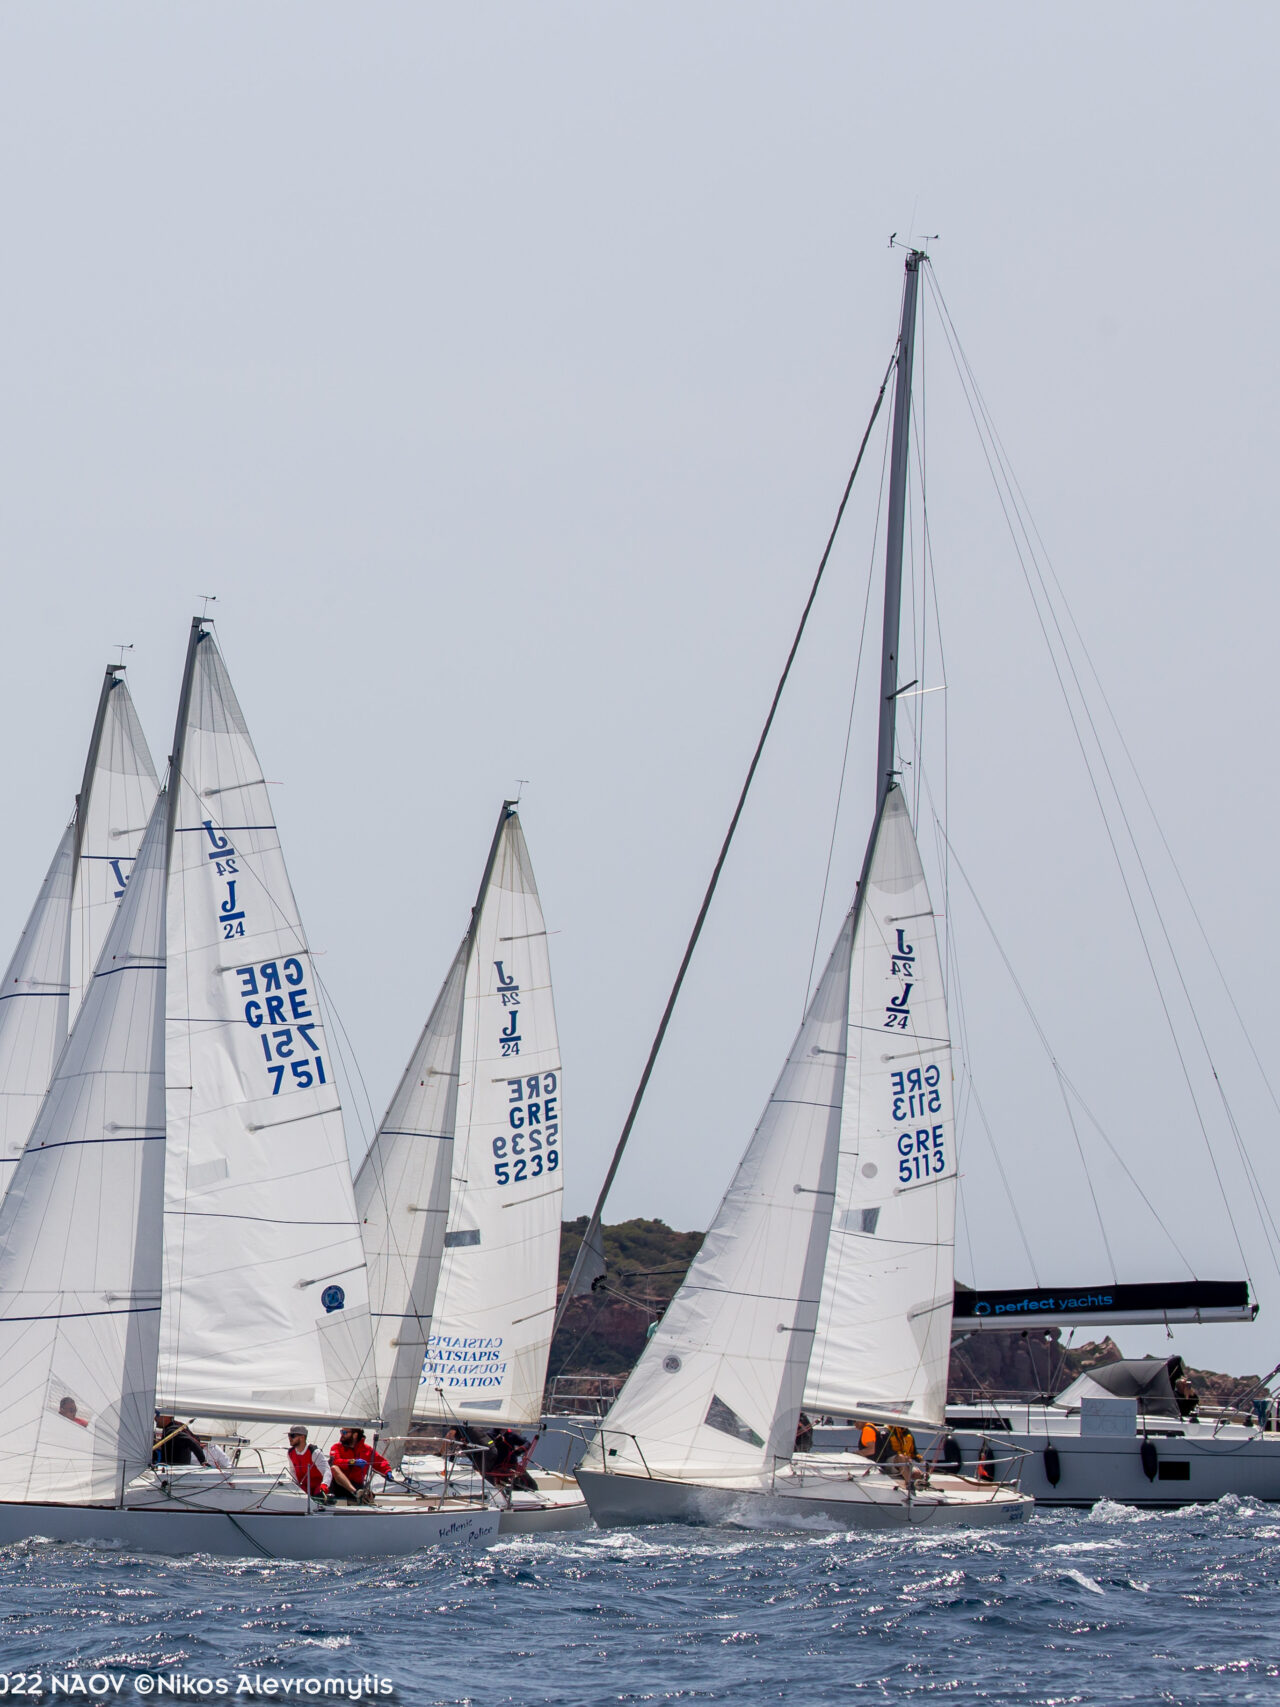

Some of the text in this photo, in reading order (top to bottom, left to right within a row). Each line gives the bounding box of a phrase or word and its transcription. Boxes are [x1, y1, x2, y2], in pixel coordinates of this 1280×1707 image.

[222, 880, 237, 913] J
[223, 921, 246, 939] 24
[890, 983, 914, 1007] J
[245, 988, 312, 1028] GRE
[502, 1010, 519, 1036] J
[884, 1014, 908, 1029] 24
[501, 1042, 520, 1057] 24
[267, 1056, 326, 1095] 751
[509, 1097, 558, 1129] GRE
[898, 1124, 944, 1156] GRE
[494, 1150, 559, 1185] 5239
[899, 1150, 945, 1182] 5113
[995, 1294, 1113, 1314] perfect yachts
[424, 1349, 500, 1361] CATSIAPIS
[438, 1519, 473, 1538] Hellenic
[468, 1527, 493, 1542] Police
